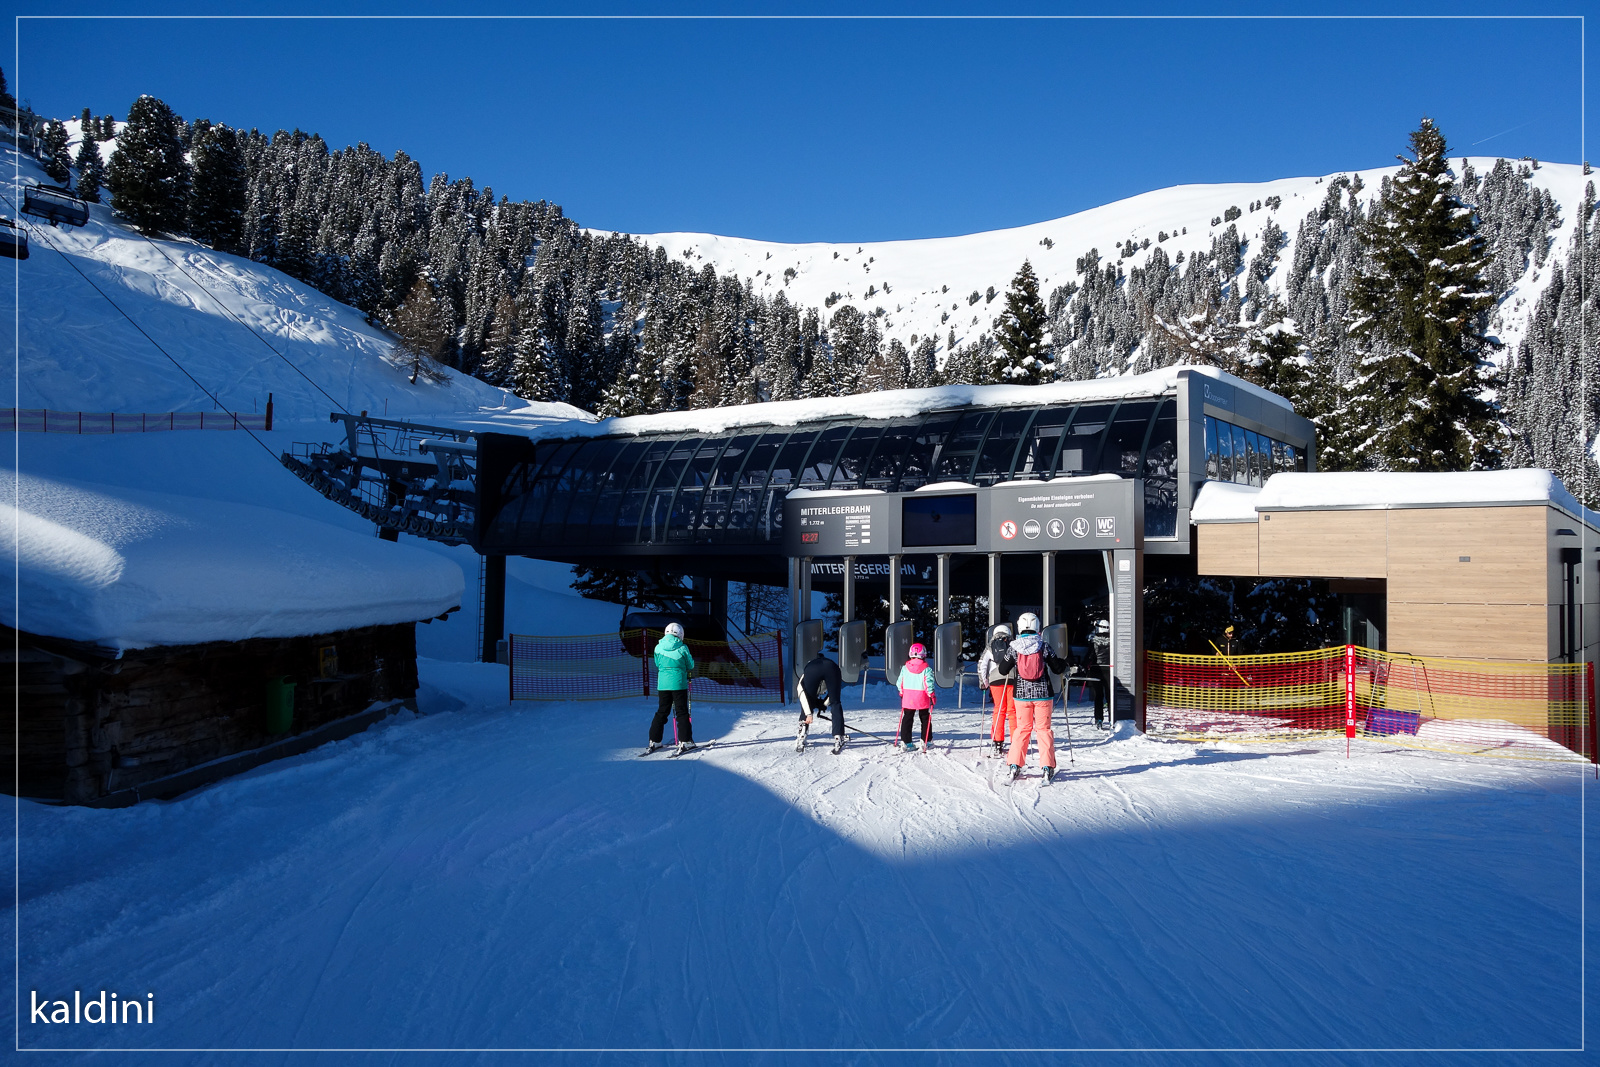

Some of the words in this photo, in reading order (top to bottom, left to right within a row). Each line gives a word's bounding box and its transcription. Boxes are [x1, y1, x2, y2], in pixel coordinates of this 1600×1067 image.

[801, 505, 870, 516] MITTERLEGERBAHN
[1097, 518, 1113, 530] WC
[811, 564, 916, 575] MITTEREGERBHN
